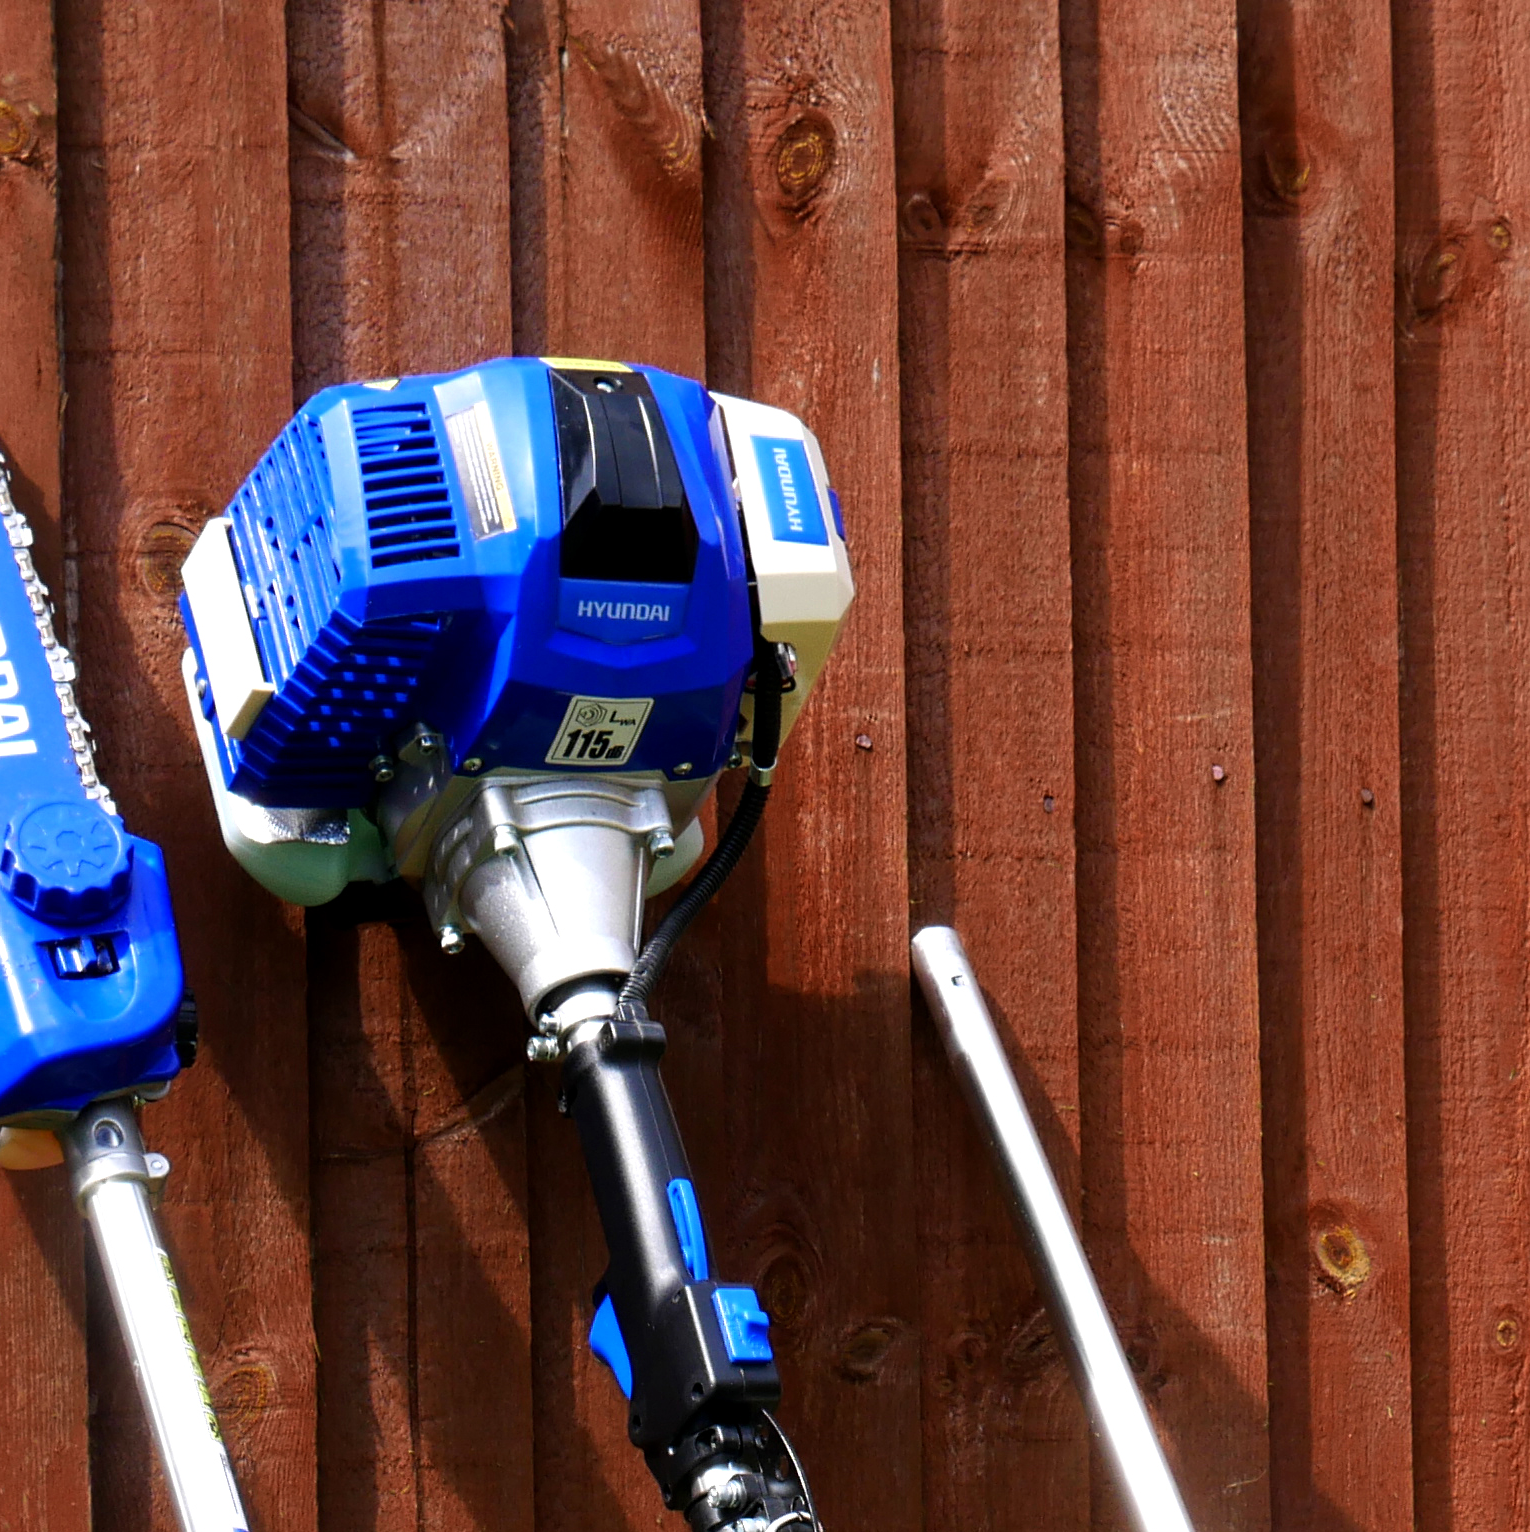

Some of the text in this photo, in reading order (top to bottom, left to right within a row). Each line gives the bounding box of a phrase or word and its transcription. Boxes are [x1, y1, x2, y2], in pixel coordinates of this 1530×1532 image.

[486, 441, 504, 491] WARNING
[773, 447, 803, 532] HYUNDAI
[577, 602, 670, 622] HYUNDAI
